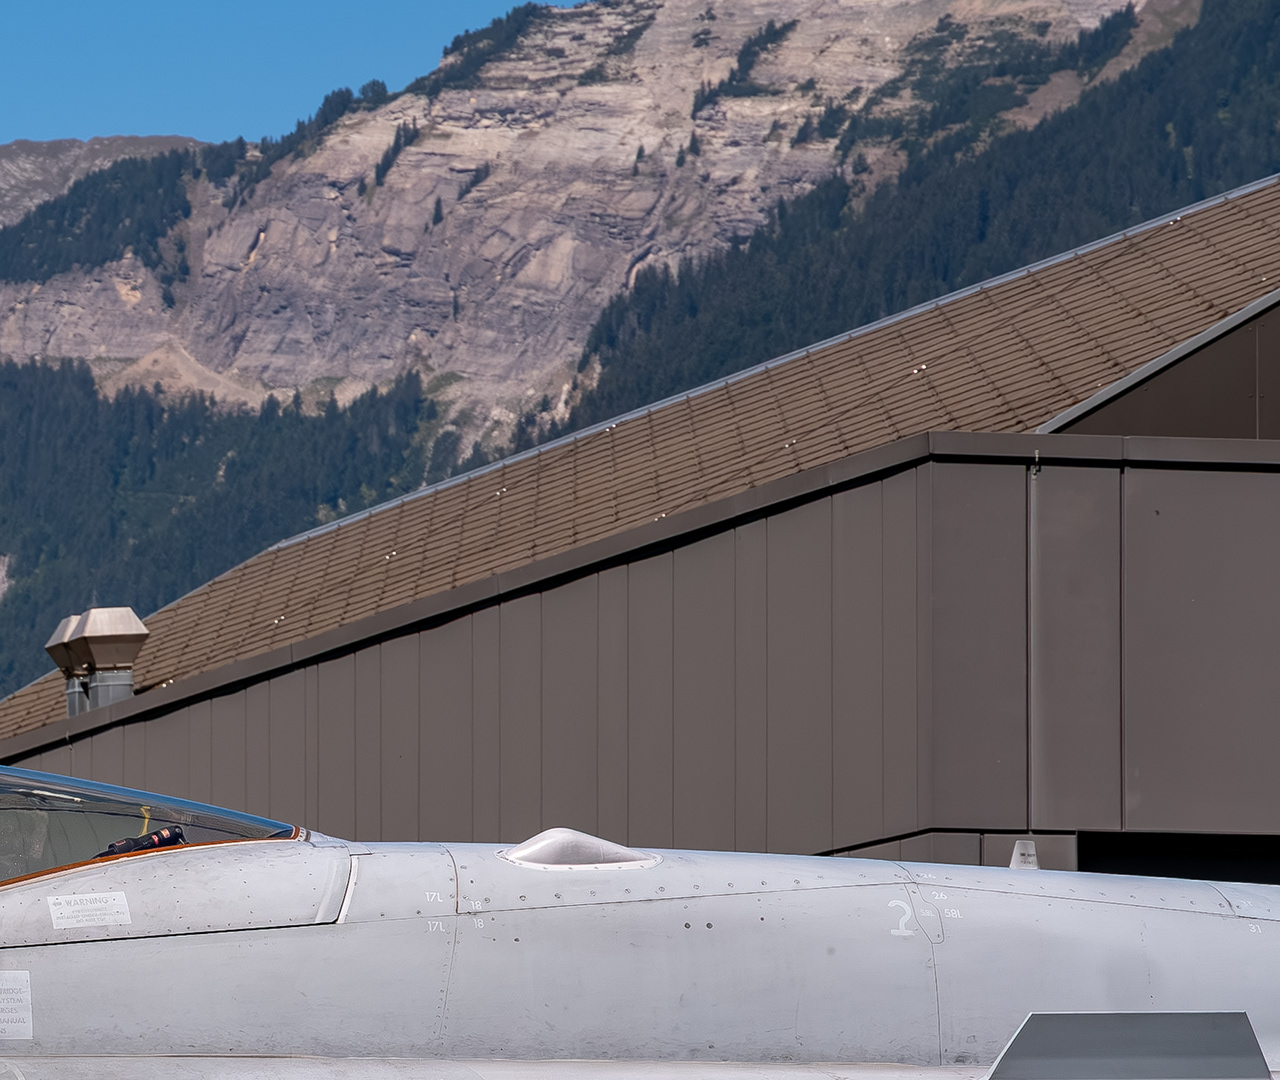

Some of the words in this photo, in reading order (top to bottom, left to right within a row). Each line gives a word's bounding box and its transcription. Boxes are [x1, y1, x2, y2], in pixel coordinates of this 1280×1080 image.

[424, 891, 444, 903] 17L
[932, 891, 948, 900] 26
[64, 896, 109, 907] WARNING
[470, 900, 482, 910] 18
[944, 908, 964, 919] 58L
[427, 921, 446, 932] 17L
[473, 918, 485, 929] 18
[1248, 923, 1263, 934] 31
